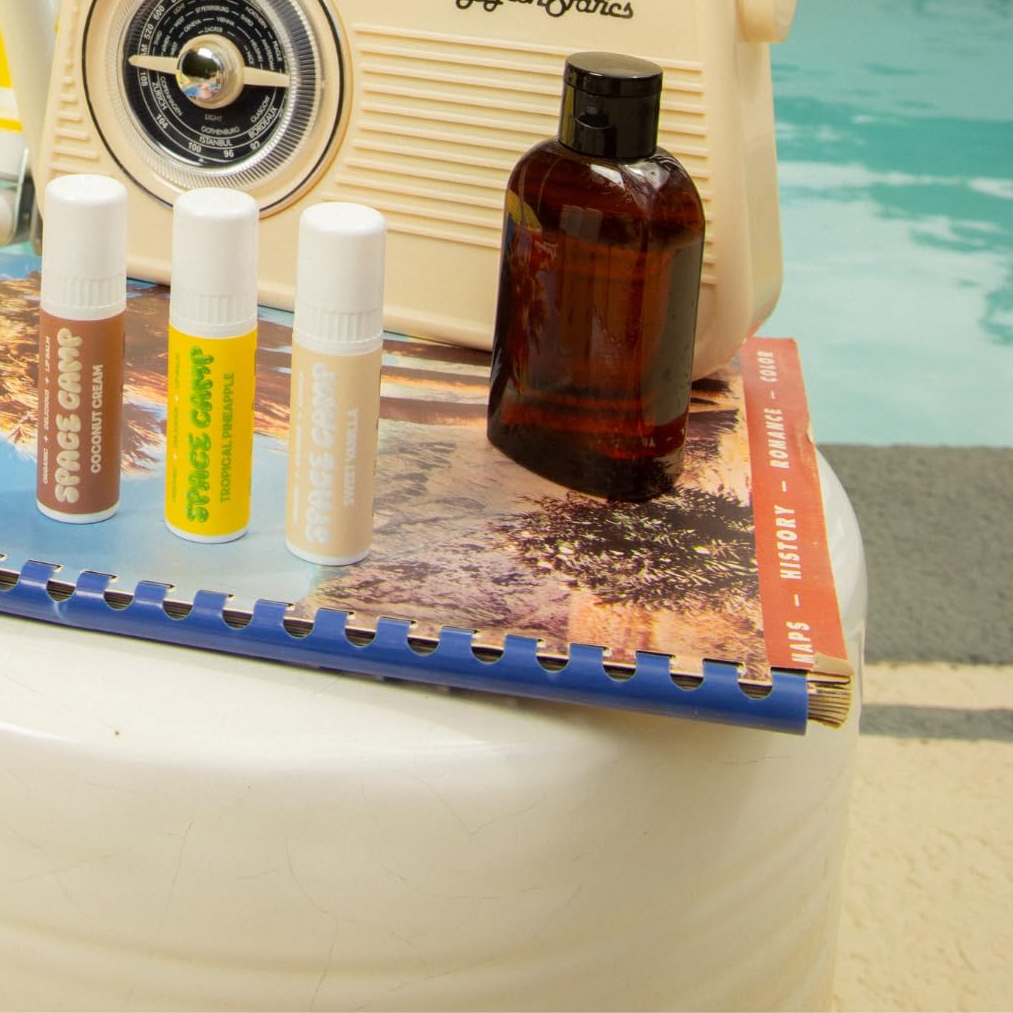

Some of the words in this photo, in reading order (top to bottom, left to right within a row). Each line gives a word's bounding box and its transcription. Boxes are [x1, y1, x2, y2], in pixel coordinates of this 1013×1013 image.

[144, 24, 154, 40] 520
[153, 5, 165, 20] 600
[140, 72, 148, 87] 108
[152, 82, 168, 110] ZURICH
[160, 76, 184, 116] COPENHAGEN
[156, 113, 168, 129] 104
[204, 114, 223, 122] LIGHT
[248, 106, 278, 139] BORDEAUX
[250, 95, 270, 123] GLASGOW
[188, 142, 202, 153] 100
[199, 136, 233, 147] ISTANBUL
[201, 126, 240, 135] GOTHENBURG
[223, 149, 234, 158] 96
[55, 326, 84, 411] CAMP
[91, 364, 104, 409] CREAM
[757, 349, 777, 383] COLOR
[186, 346, 215, 429] CAMP
[221, 372, 235, 439] PINEAPPLE
[306, 362, 340, 448] CAMP
[42, 388, 50, 430] DELICIOUS
[90, 410, 104, 474] COCONUT
[344, 408, 360, 462] VANILLA
[763, 408, 790, 470] ROMANCE
[41, 447, 50, 485] ORGANIC
[54, 413, 83, 504] SPACE
[183, 432, 212, 523] SPACE
[220, 440, 234, 503] TROPICAL
[304, 450, 334, 545] SPACE
[342, 463, 358, 507] SWEET
[774, 504, 803, 580] HISTORY
[785, 621, 814, 665] MAPS
